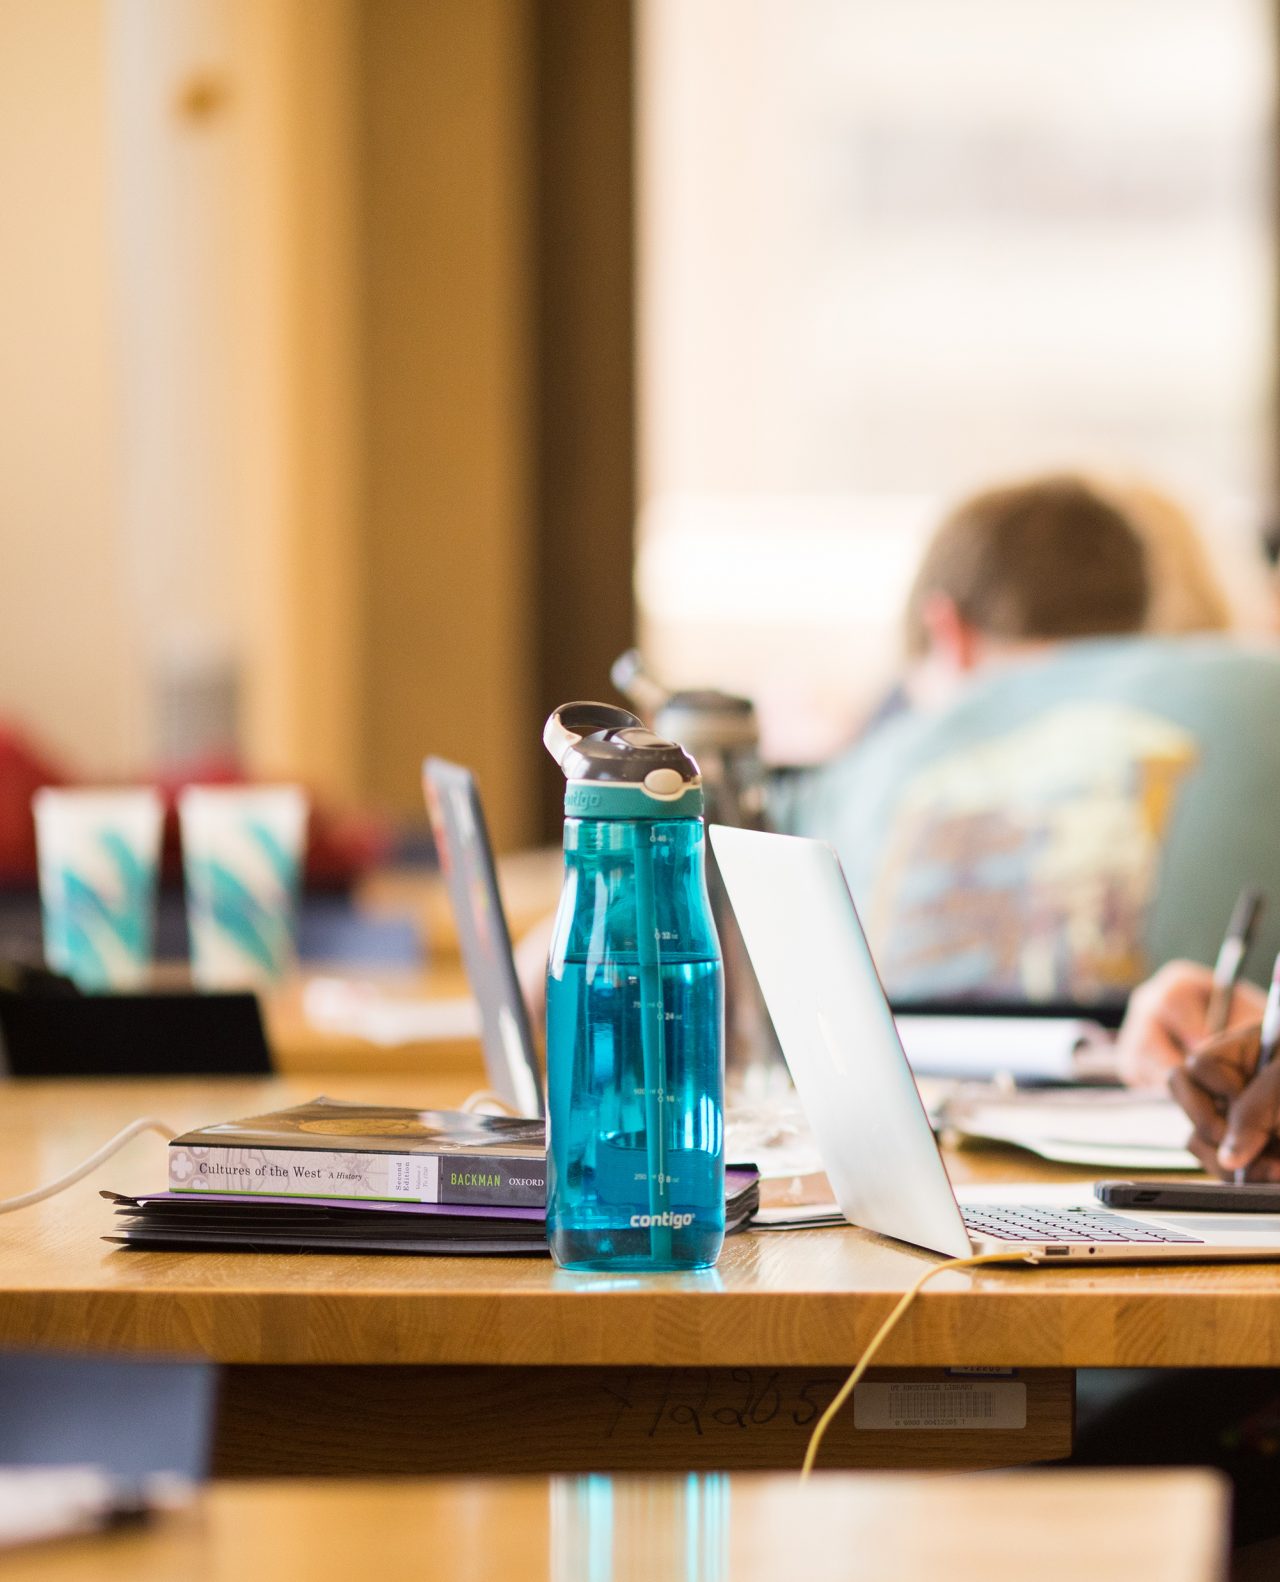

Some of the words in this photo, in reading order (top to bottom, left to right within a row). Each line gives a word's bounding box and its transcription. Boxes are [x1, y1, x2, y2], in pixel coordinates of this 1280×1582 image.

[665, 1012, 675, 1021] 24
[199, 1163, 251, 1176] Cultures
[254, 1164, 268, 1176] of
[270, 1165, 289, 1177] the
[293, 1166, 322, 1179] West
[328, 1172, 335, 1180] A
[336, 1172, 363, 1182] History
[450, 1172, 501, 1187] BACKMAN
[508, 1177, 545, 1187] OXFORD
[630, 1211, 692, 1229] contigo
